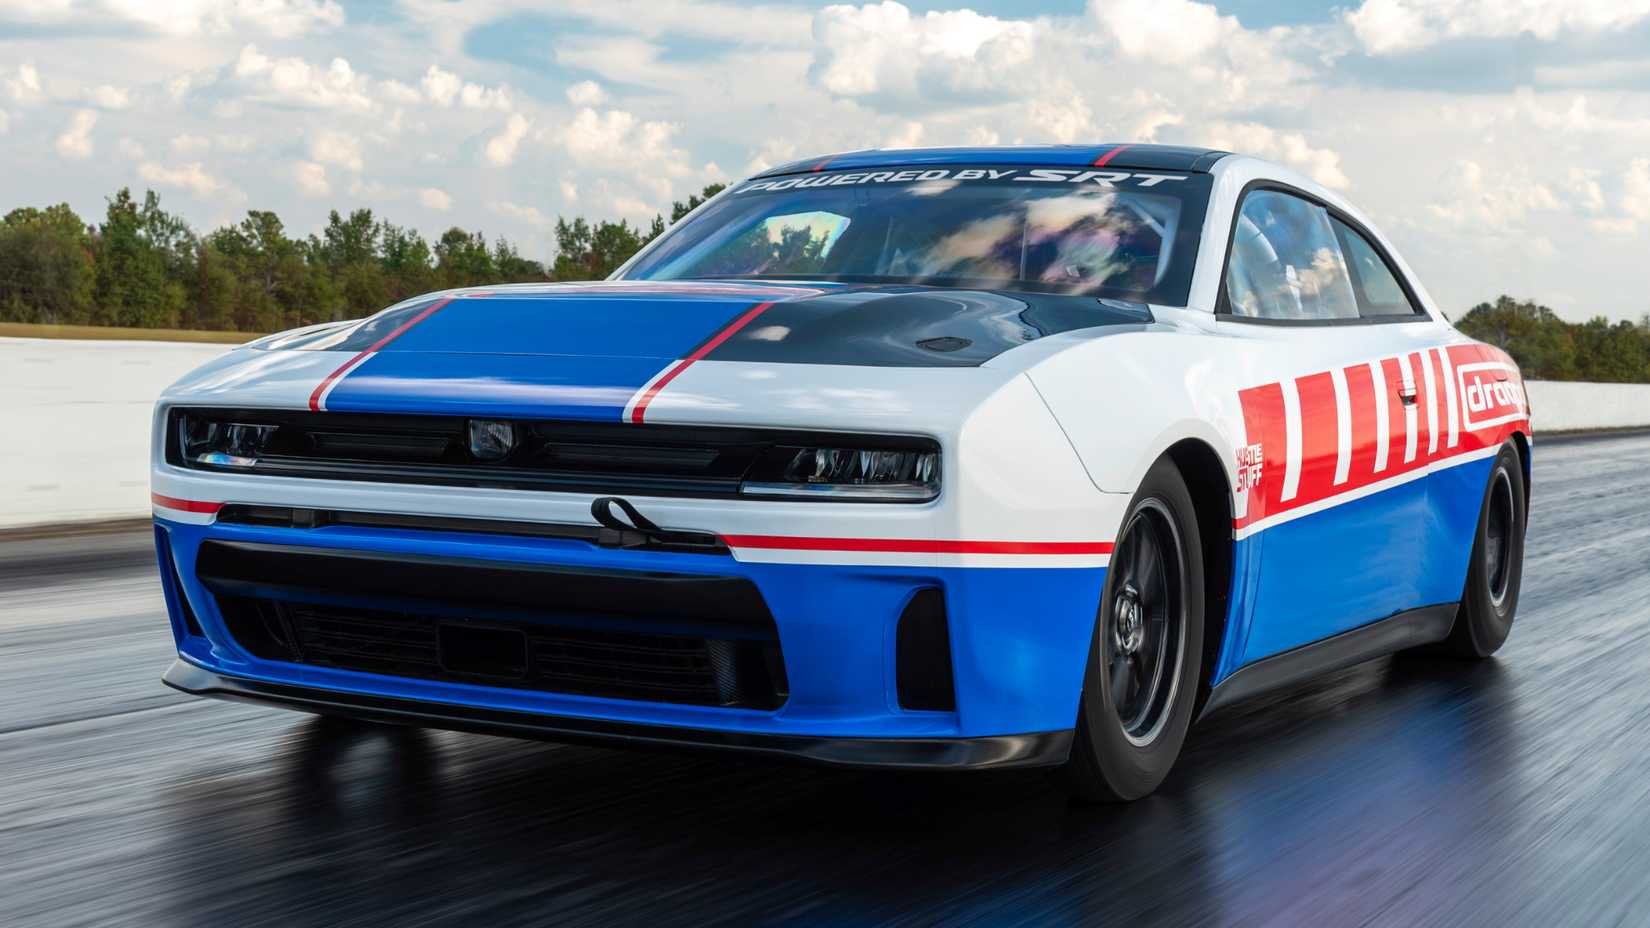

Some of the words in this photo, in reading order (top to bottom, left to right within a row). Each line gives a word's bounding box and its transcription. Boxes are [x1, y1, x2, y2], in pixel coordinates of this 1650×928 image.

[735, 170, 949, 193] POWERED
[952, 169, 1018, 180] BY
[1013, 169, 1188, 188] SRT
